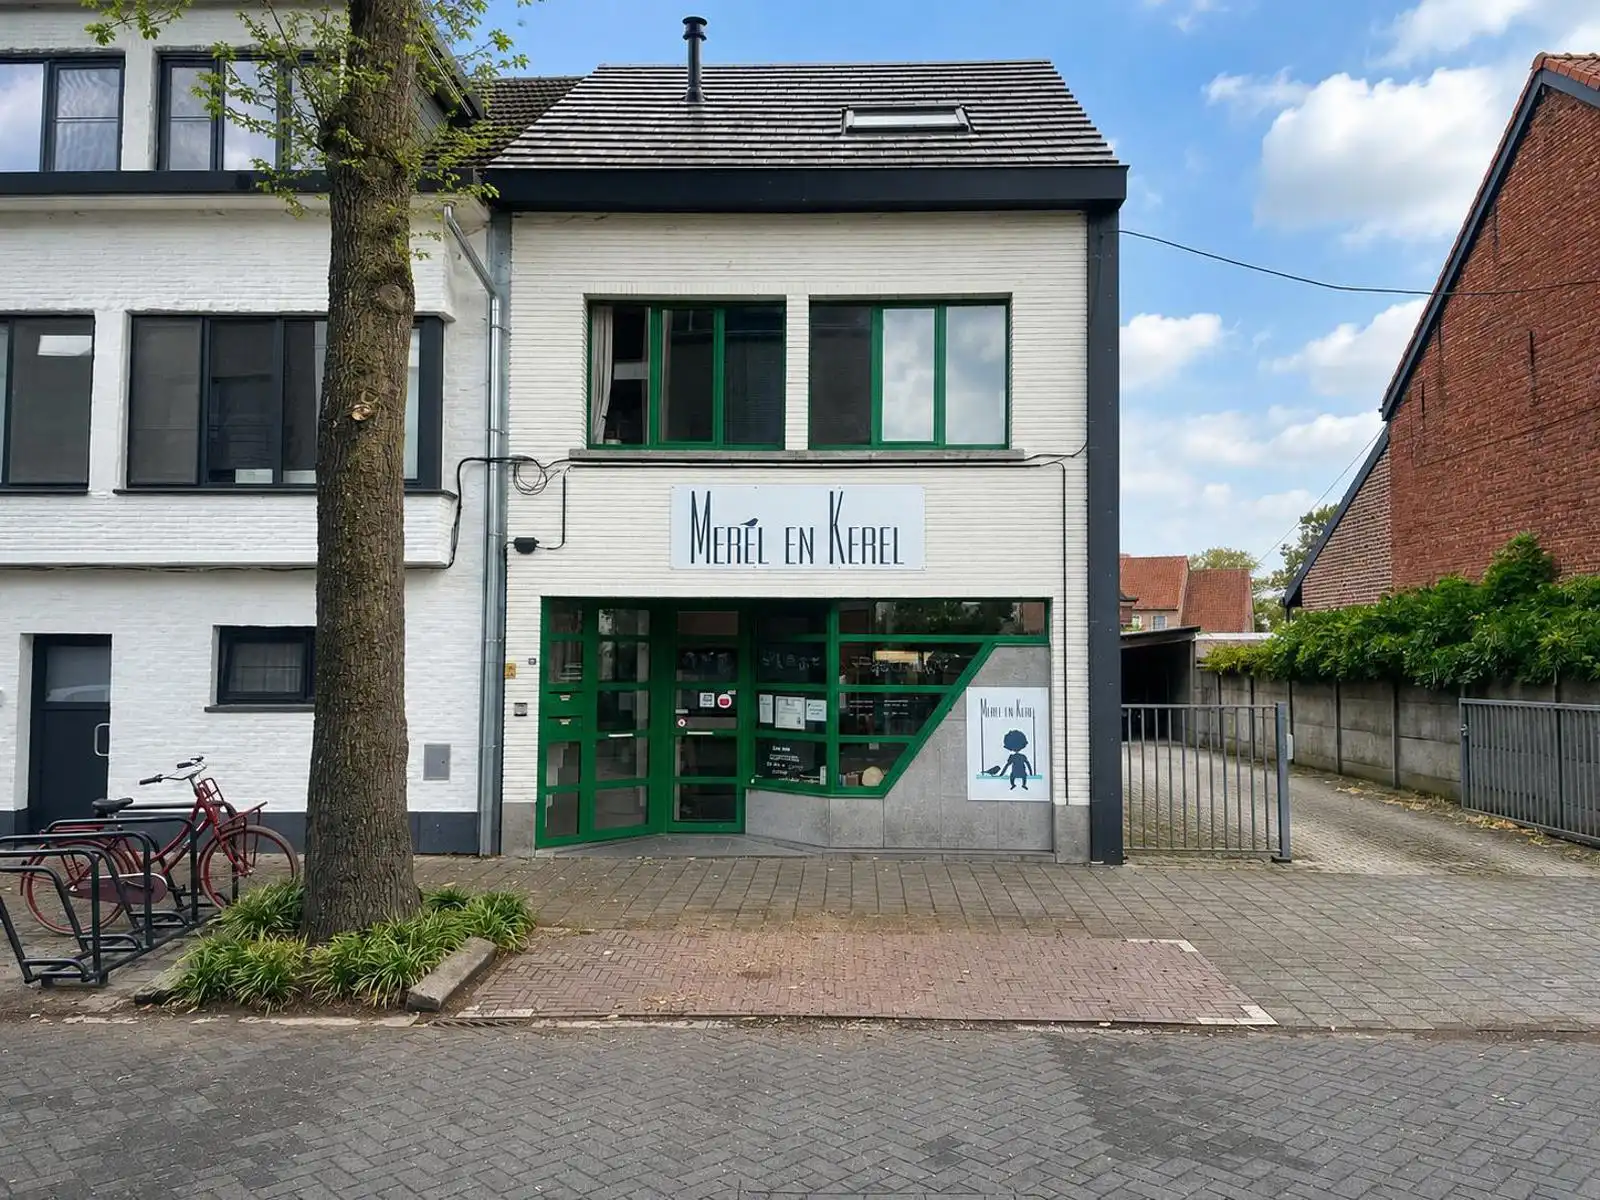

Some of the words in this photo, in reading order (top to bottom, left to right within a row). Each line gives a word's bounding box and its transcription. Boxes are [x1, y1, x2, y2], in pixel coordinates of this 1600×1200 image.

[690, 490, 769, 565] MEREL
[785, 526, 814, 565] EN
[829, 490, 905, 565] KEREL
